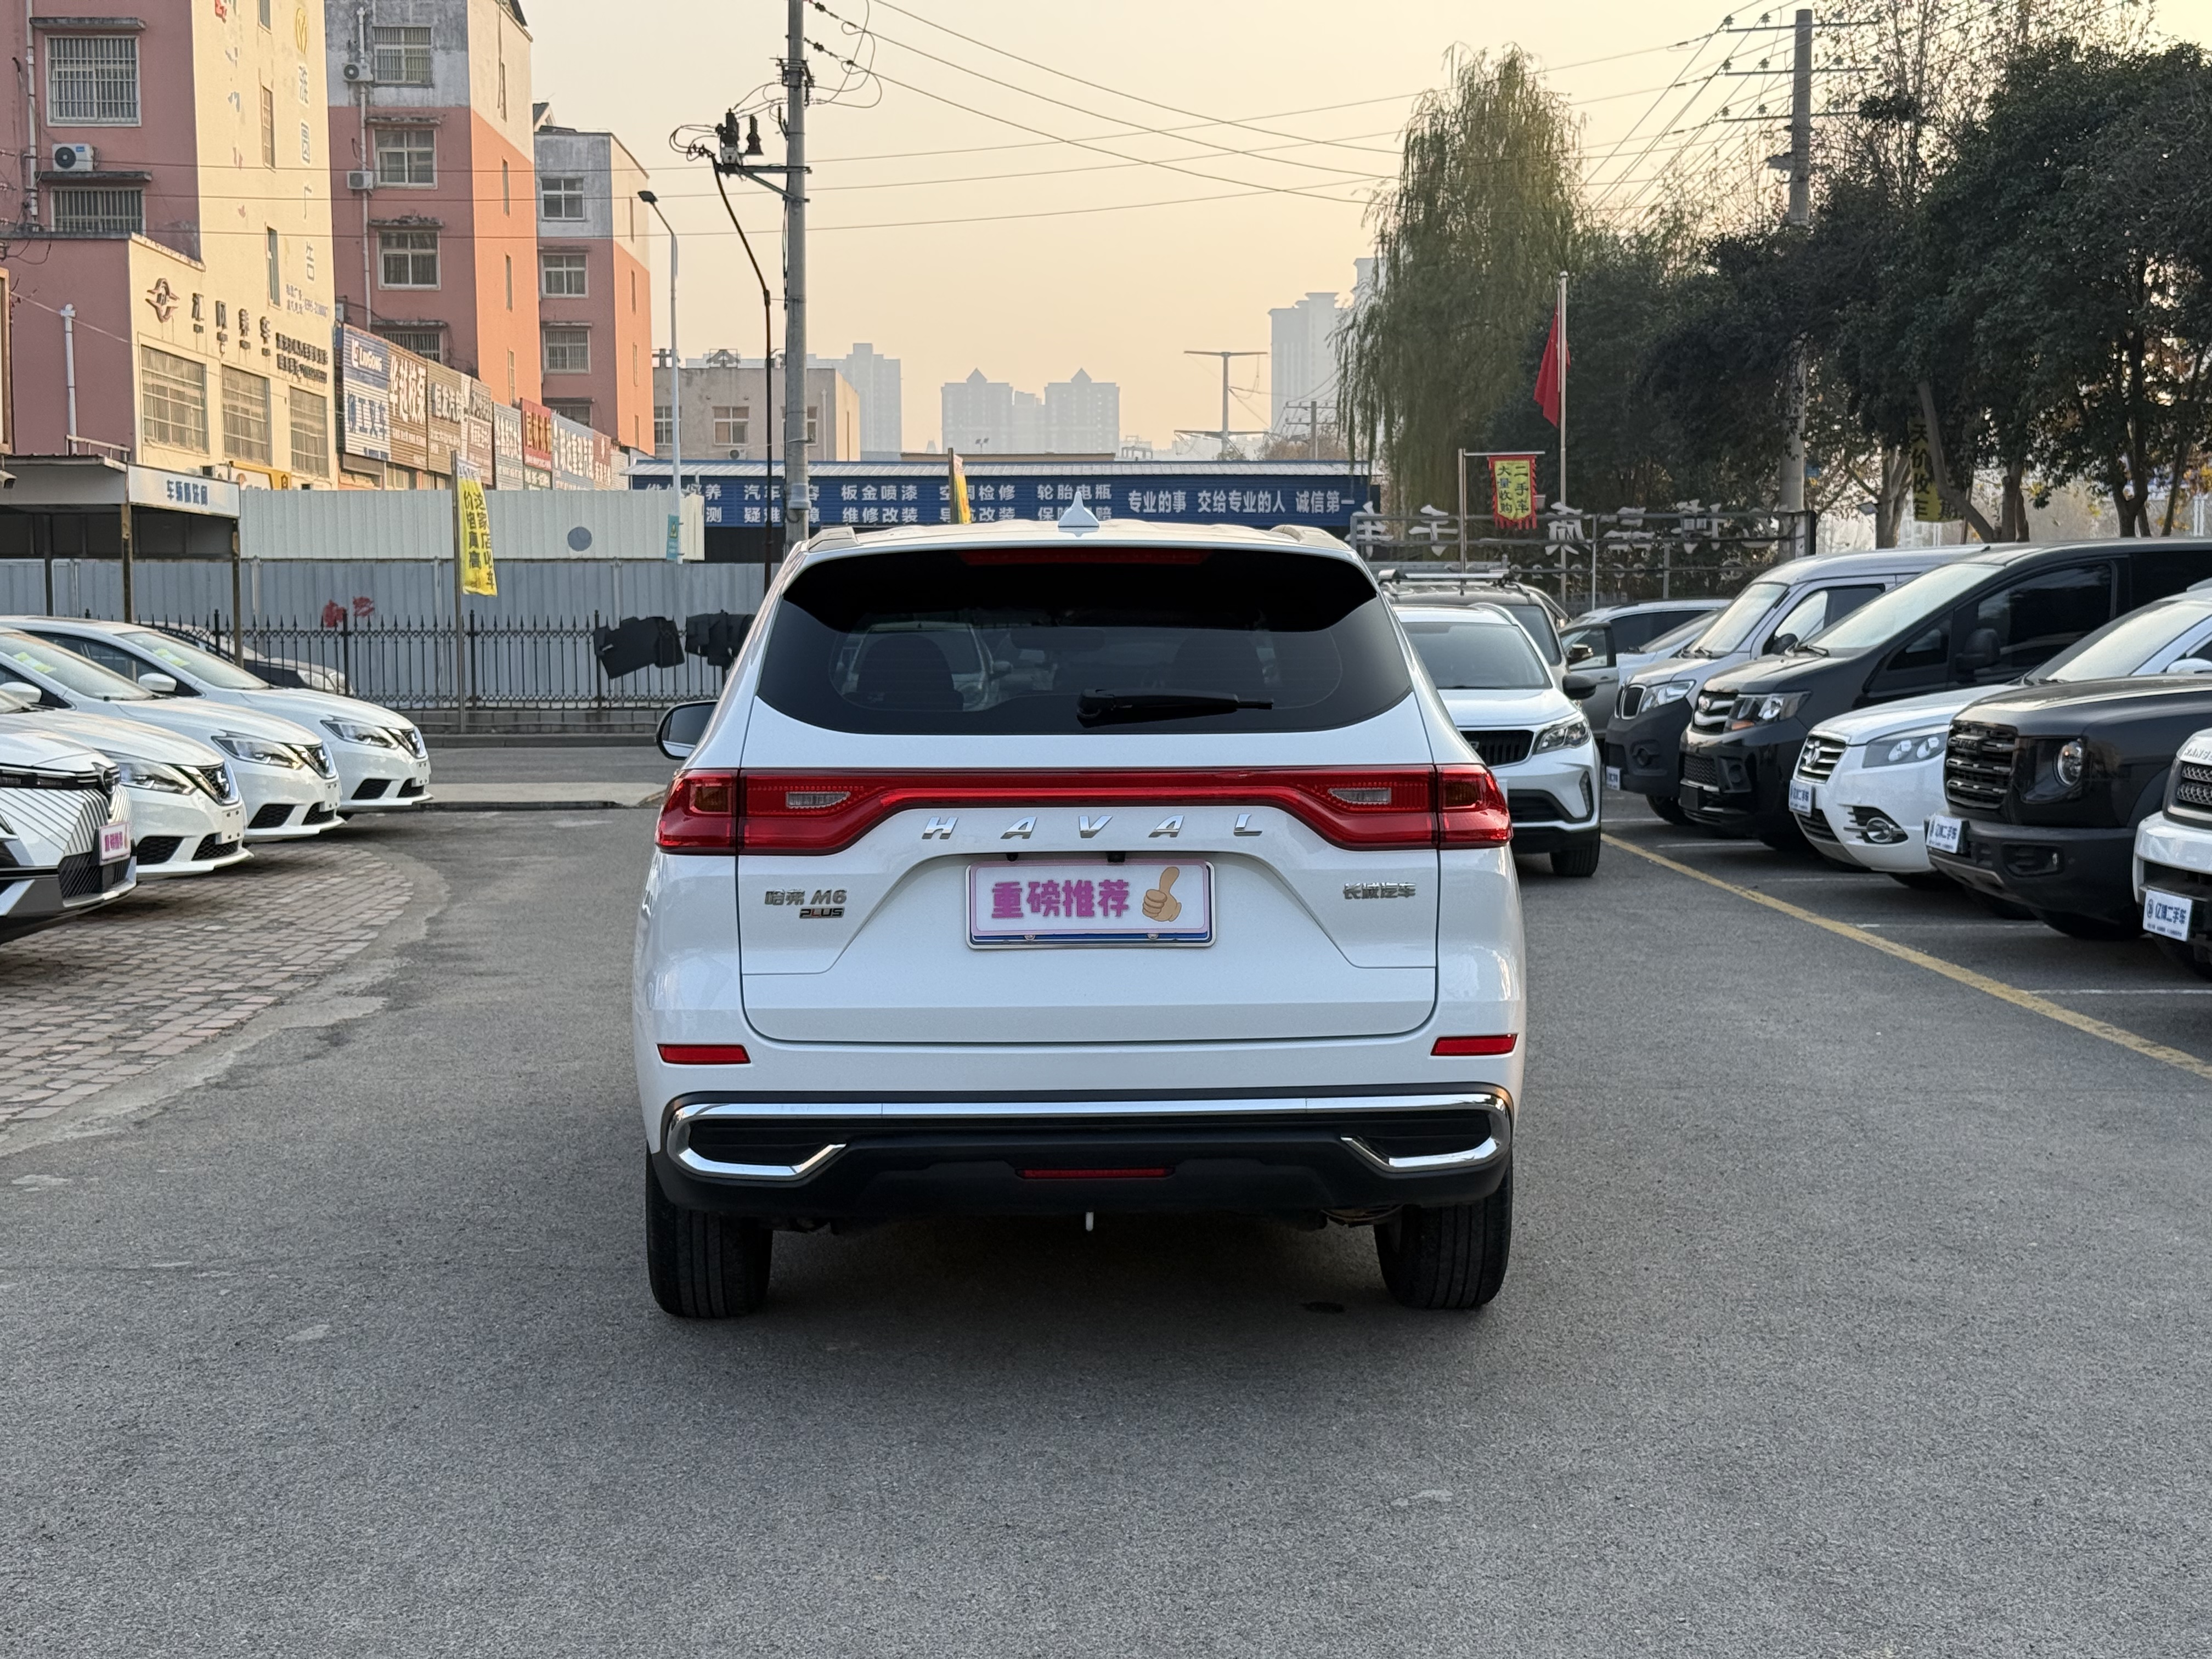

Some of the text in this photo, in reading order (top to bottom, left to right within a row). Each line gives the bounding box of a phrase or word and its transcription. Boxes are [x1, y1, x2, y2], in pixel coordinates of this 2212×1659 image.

[744, 484, 820, 500] 汽车容
[842, 484, 917, 501] 板金喷漆
[1037, 484, 1112, 500] 轮胎电瓶
[1497, 466, 1512, 513] 大量收购
[1514, 466, 1528, 513] 二手车
[1128, 490, 1355, 514] 专业的事 交给专业的人 诚信第一
[744, 506, 820, 523] 疑难障
[842, 506, 918, 523] 维修改装
[1038, 506, 1112, 521] 保赔
[922, 814, 1262, 839] HAVAL
[765, 888, 848, 906] 哈弗 M6
[991, 879, 1129, 919] 重磅推荐
[1343, 882, 1416, 900] 长城汽车
[799, 907, 845, 919] PLUS
